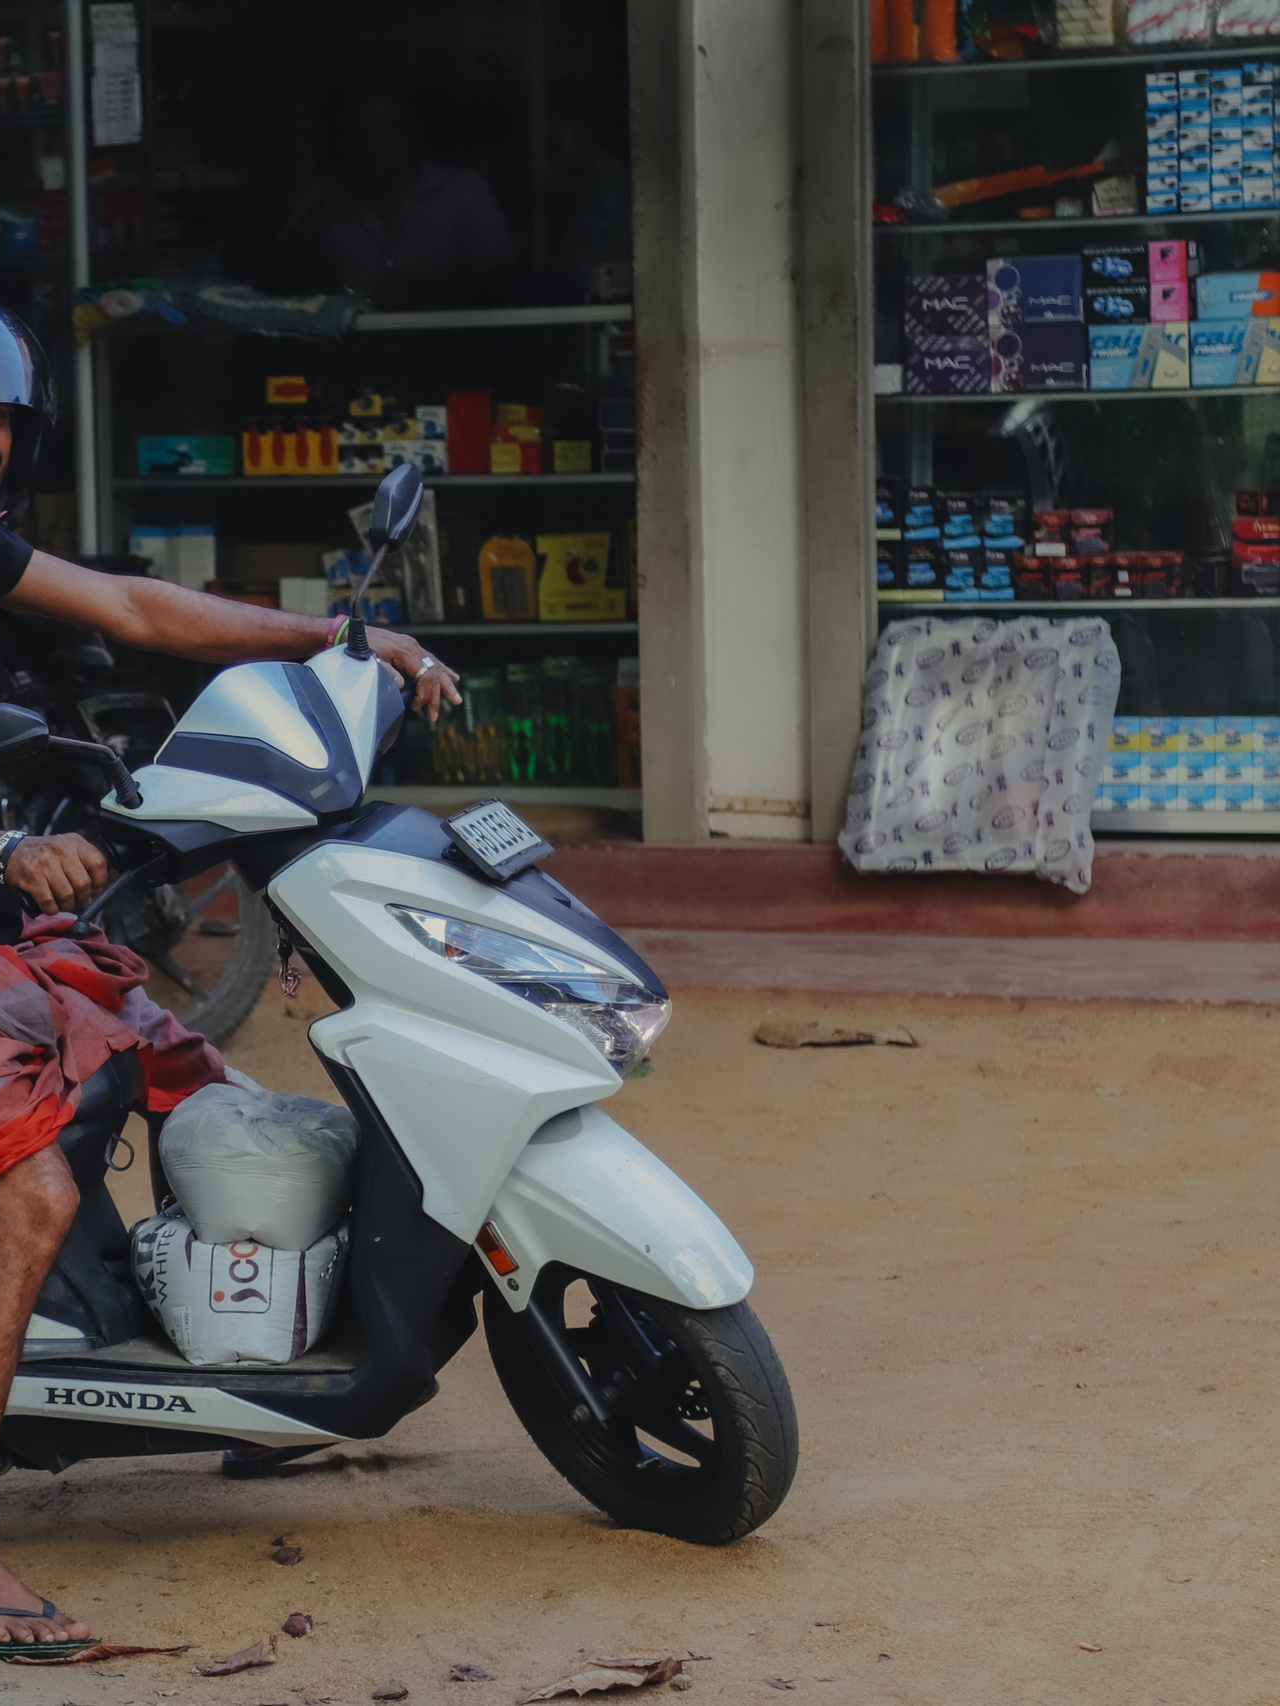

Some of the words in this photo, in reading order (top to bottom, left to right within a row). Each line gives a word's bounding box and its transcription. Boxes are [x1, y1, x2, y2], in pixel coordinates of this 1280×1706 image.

[922, 296, 970, 312] MAC
[924, 355, 972, 371] MAC
[156, 1228, 177, 1305] WHITE
[45, 1387, 196, 1413] HONDA
